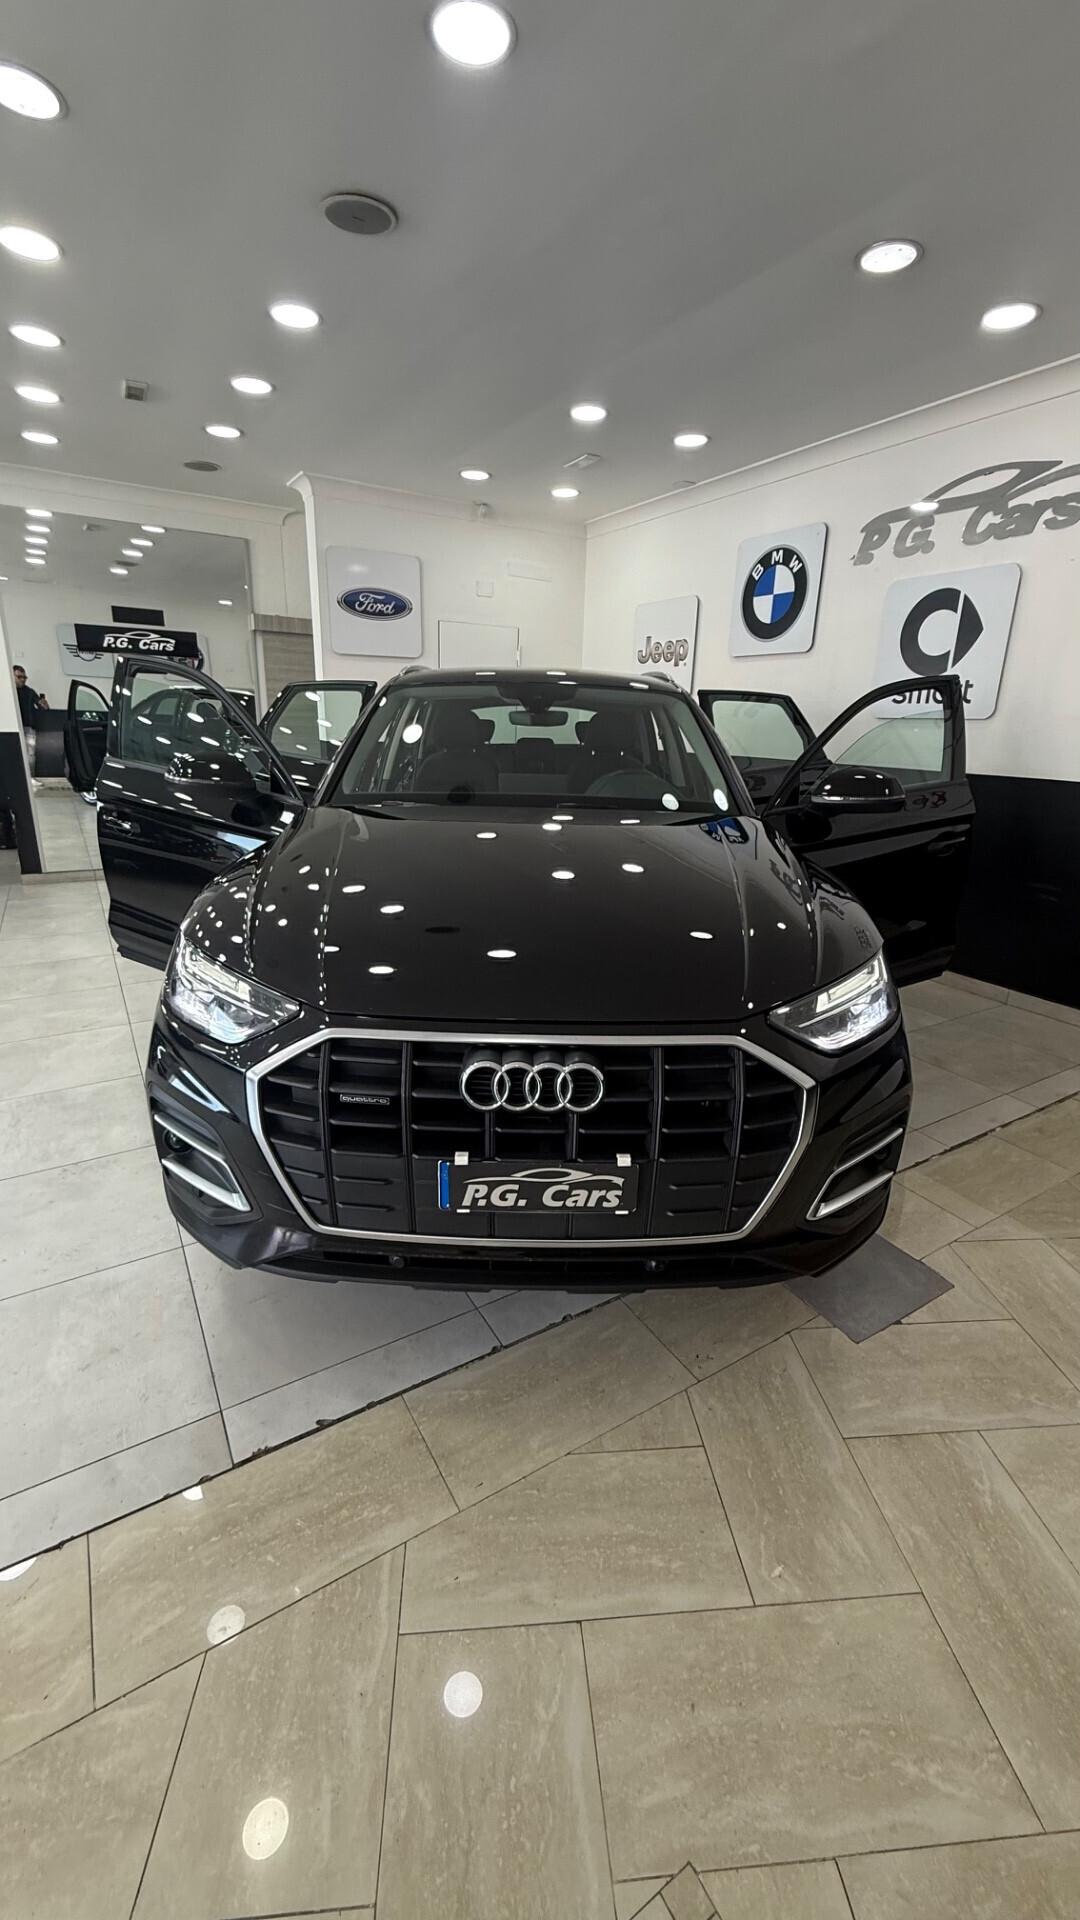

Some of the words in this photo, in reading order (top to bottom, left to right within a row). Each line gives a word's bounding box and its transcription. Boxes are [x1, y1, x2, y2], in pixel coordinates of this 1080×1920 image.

[961, 491, 1080, 546] Cars
[752, 549, 803, 581] BMW
[355, 592, 396, 614] Ford
[103, 636, 132, 649] P.G.
[138, 638, 175, 652] Cars
[637, 635, 689, 667] Jeep
[461, 1184, 528, 1208] P.G.
[542, 1184, 623, 1208] Cars
